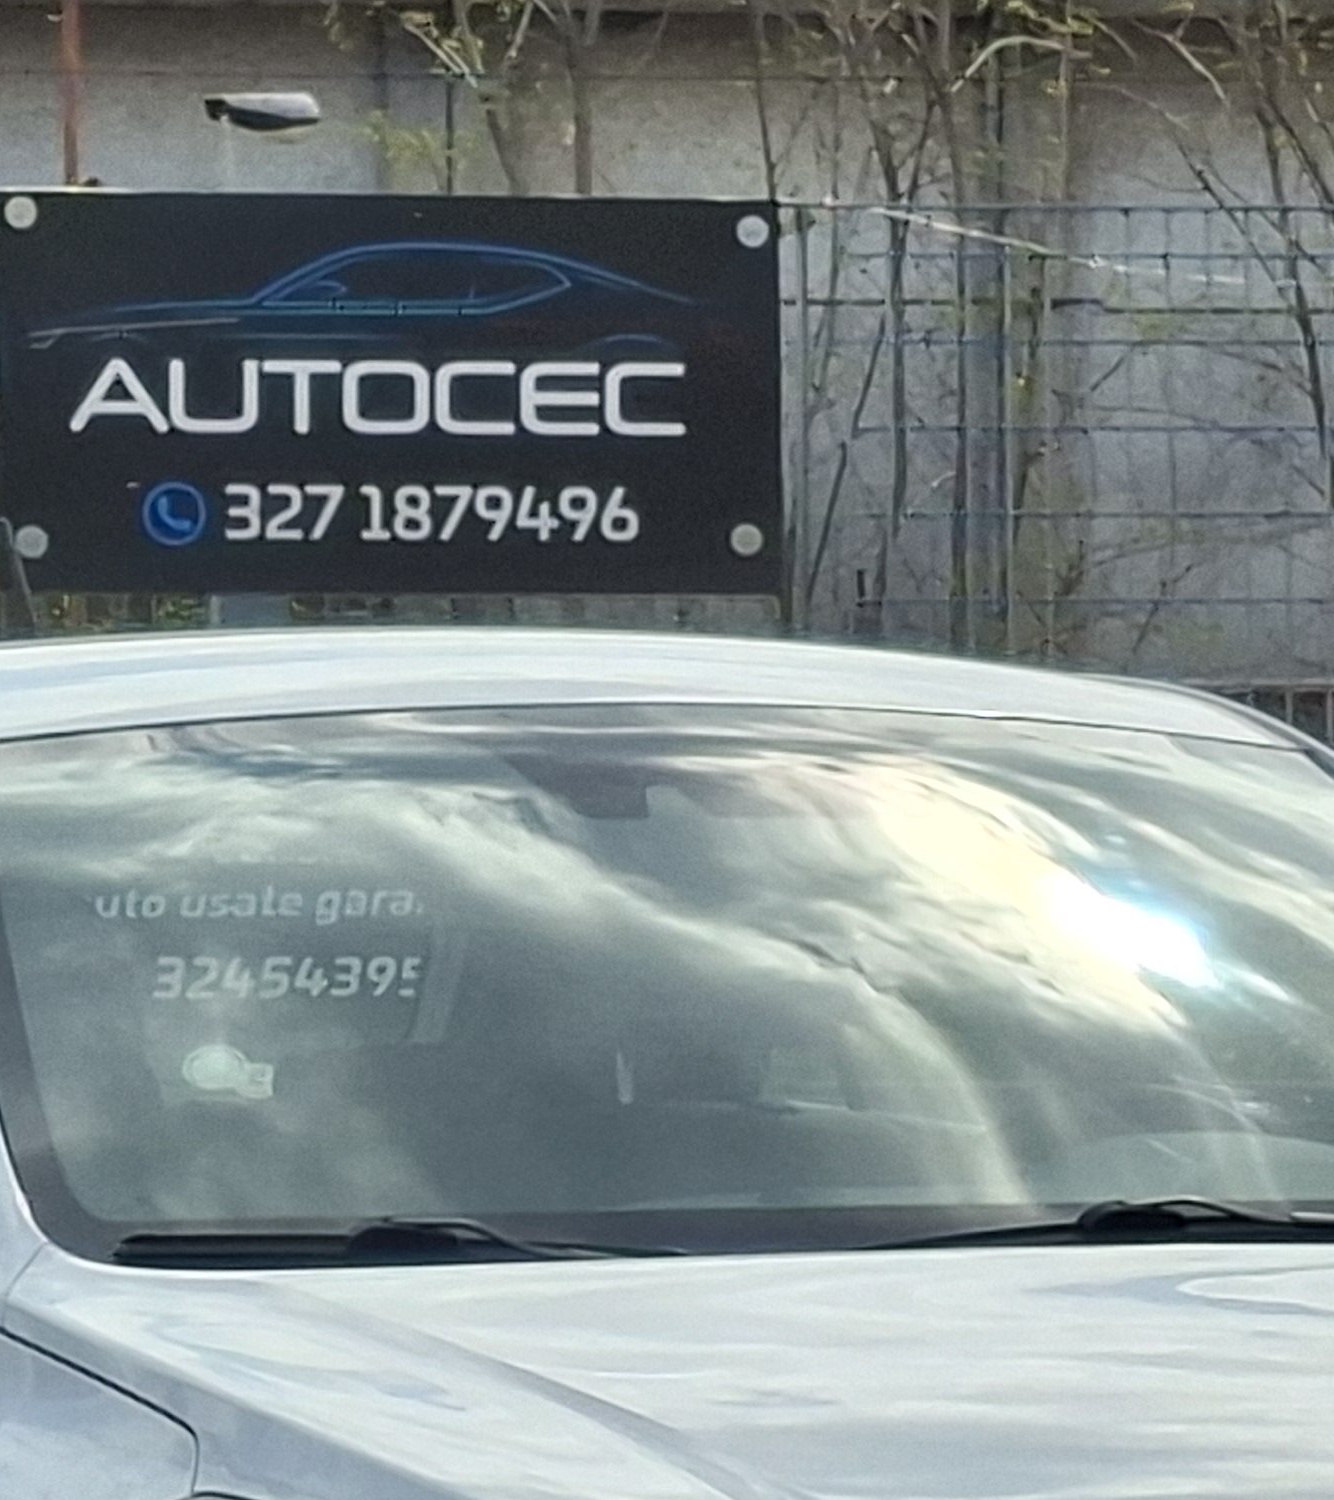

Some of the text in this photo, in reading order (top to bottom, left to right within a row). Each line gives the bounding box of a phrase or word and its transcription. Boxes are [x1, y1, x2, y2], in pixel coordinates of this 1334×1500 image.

[69, 357, 687, 438] AUTOCEC
[224, 483, 641, 544] 327 1879496
[87, 889, 167, 919] uto
[314, 887, 424, 926] gara
